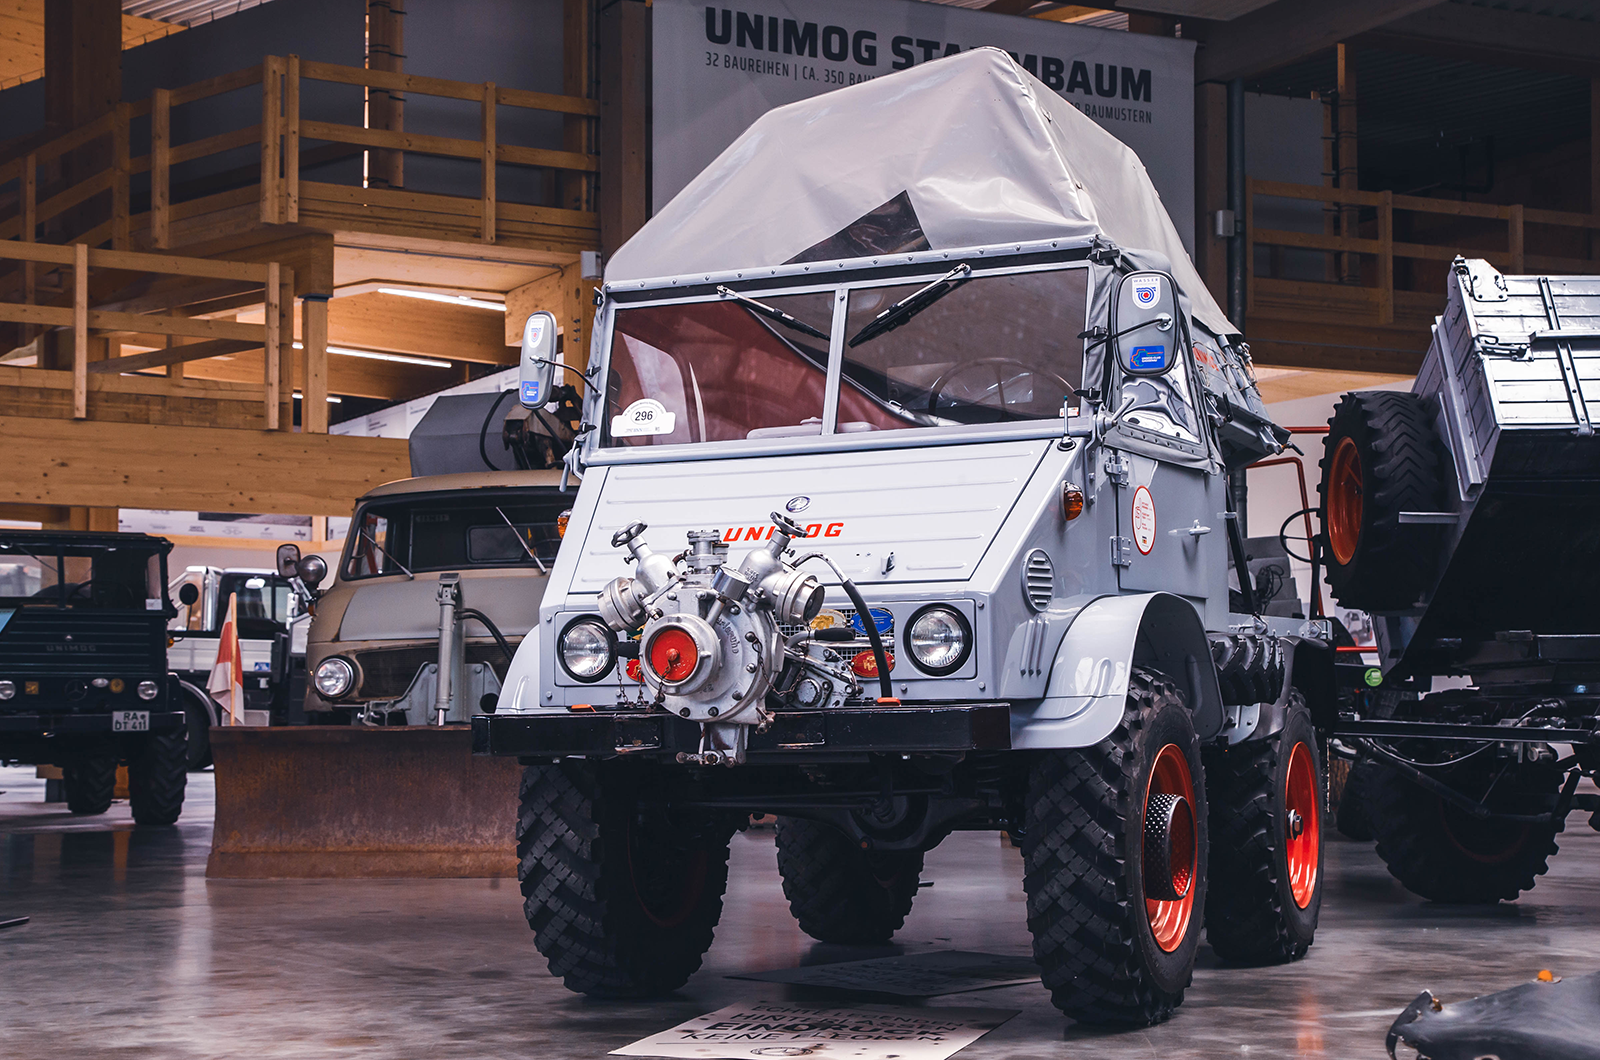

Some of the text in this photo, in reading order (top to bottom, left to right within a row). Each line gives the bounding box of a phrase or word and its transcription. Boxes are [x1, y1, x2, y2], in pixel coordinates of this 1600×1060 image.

[705, 6, 1152, 102] UNIMOG STBAUM
[706, 52, 719, 67] 32
[724, 57, 789, 77] BAUREIHEN
[802, 66, 820, 81] CA.
[824, 69, 845, 84] 350
[1085, 103, 1152, 124] BAUMUSTERN
[635, 411, 654, 421] 296
[723, 522, 844, 543] UNIOG
[124, 712, 138, 720] RA
[132, 721, 147, 730] 411
[704, 1022, 950, 1036] EINDRUCK
